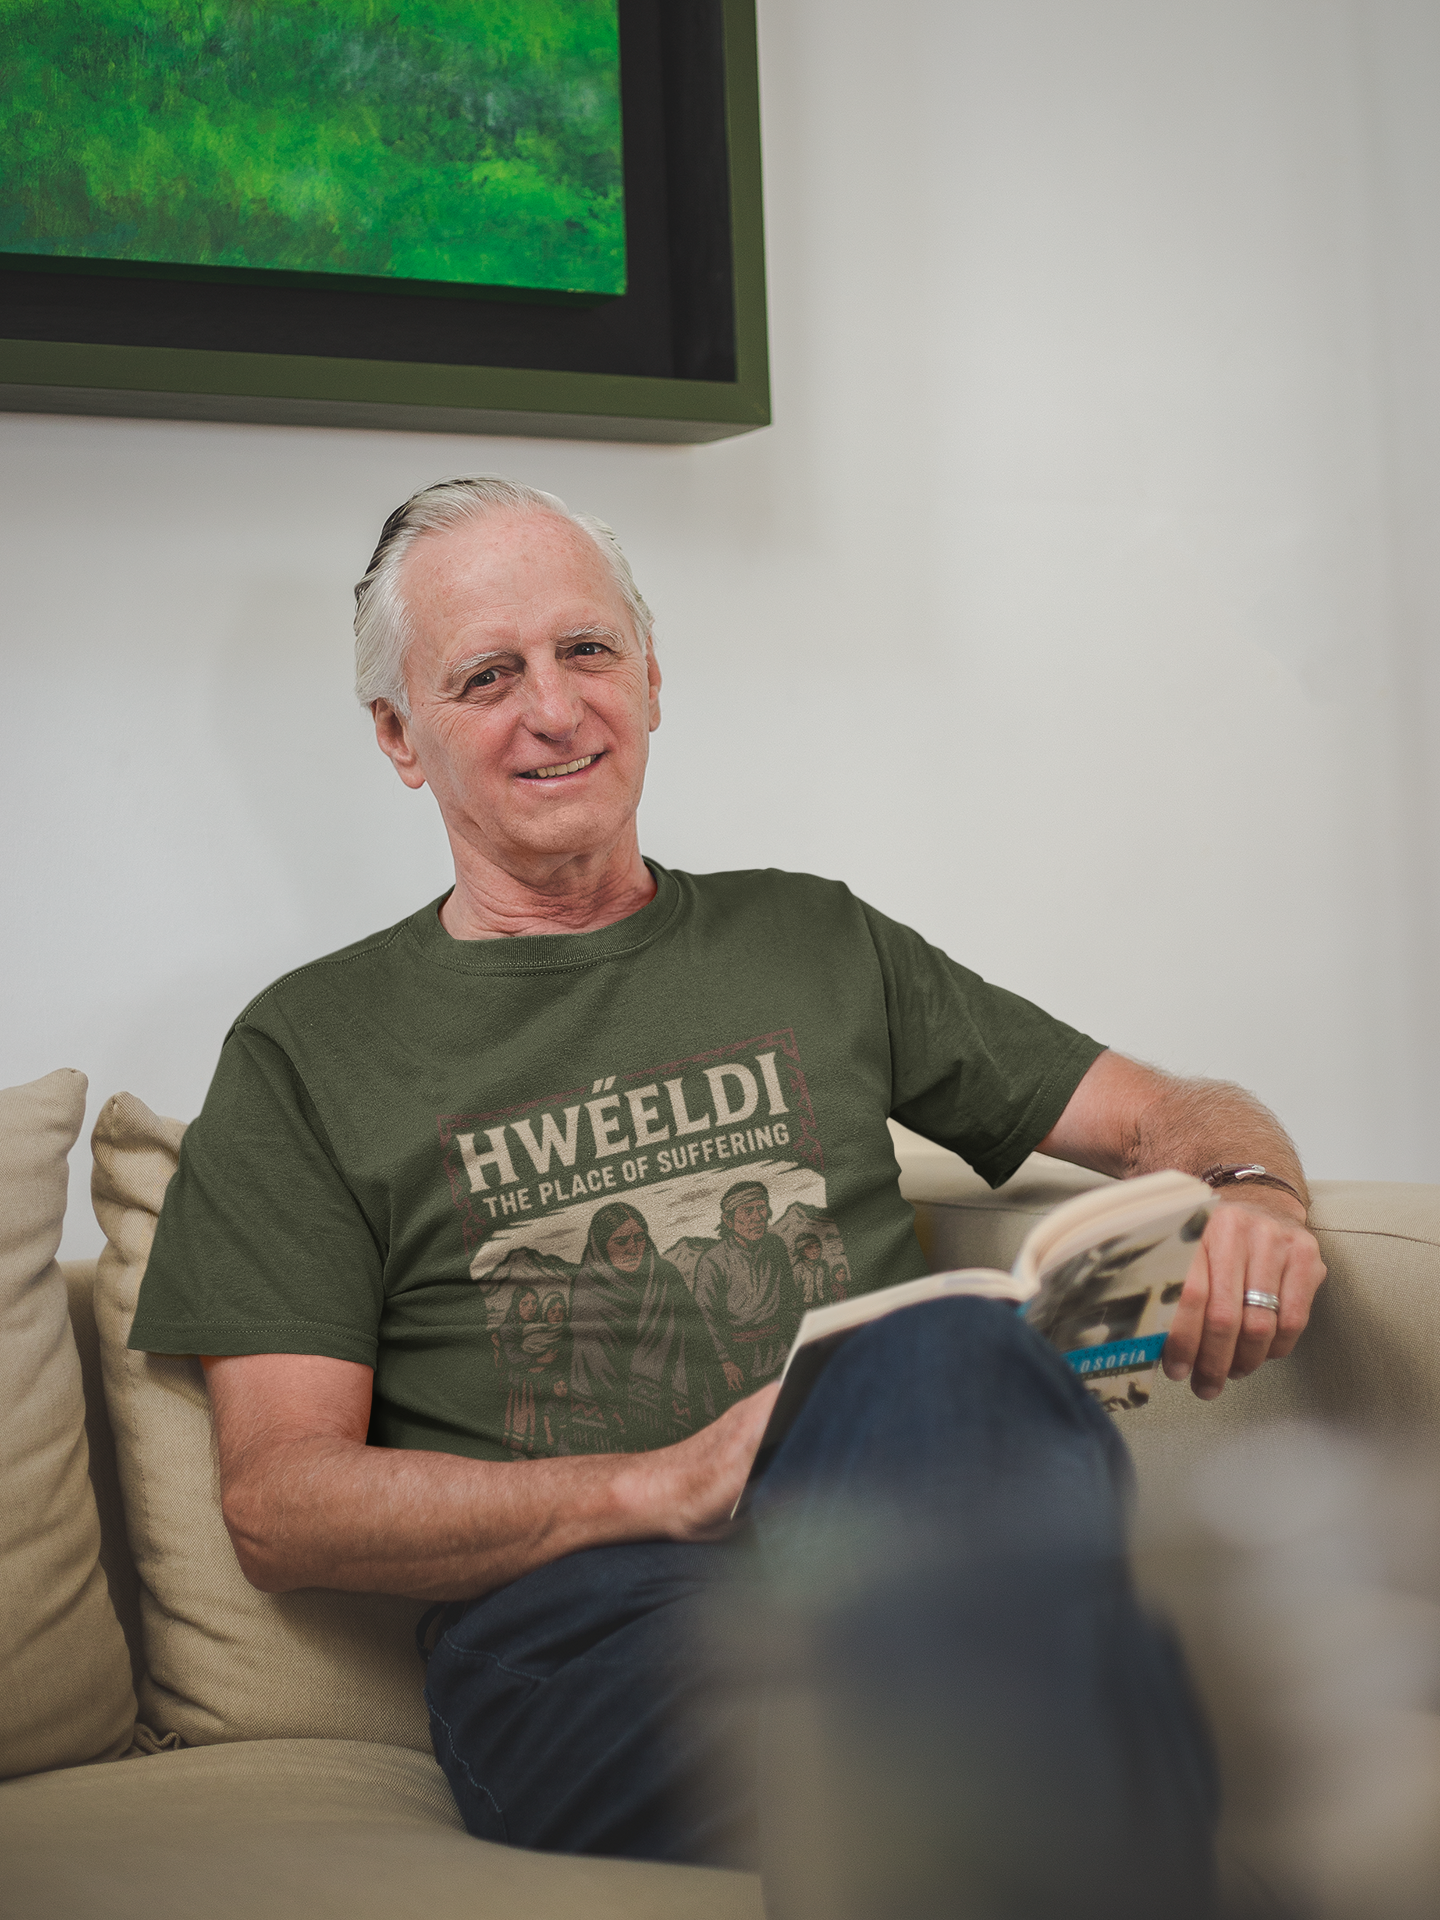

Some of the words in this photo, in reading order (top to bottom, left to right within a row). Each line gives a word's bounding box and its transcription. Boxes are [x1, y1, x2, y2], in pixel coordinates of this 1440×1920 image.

[482, 1187, 533, 1218] THE
[538, 1165, 617, 1206] PLACE
[621, 1155, 649, 1183] OF
[656, 1122, 790, 1174] SUFFERING
